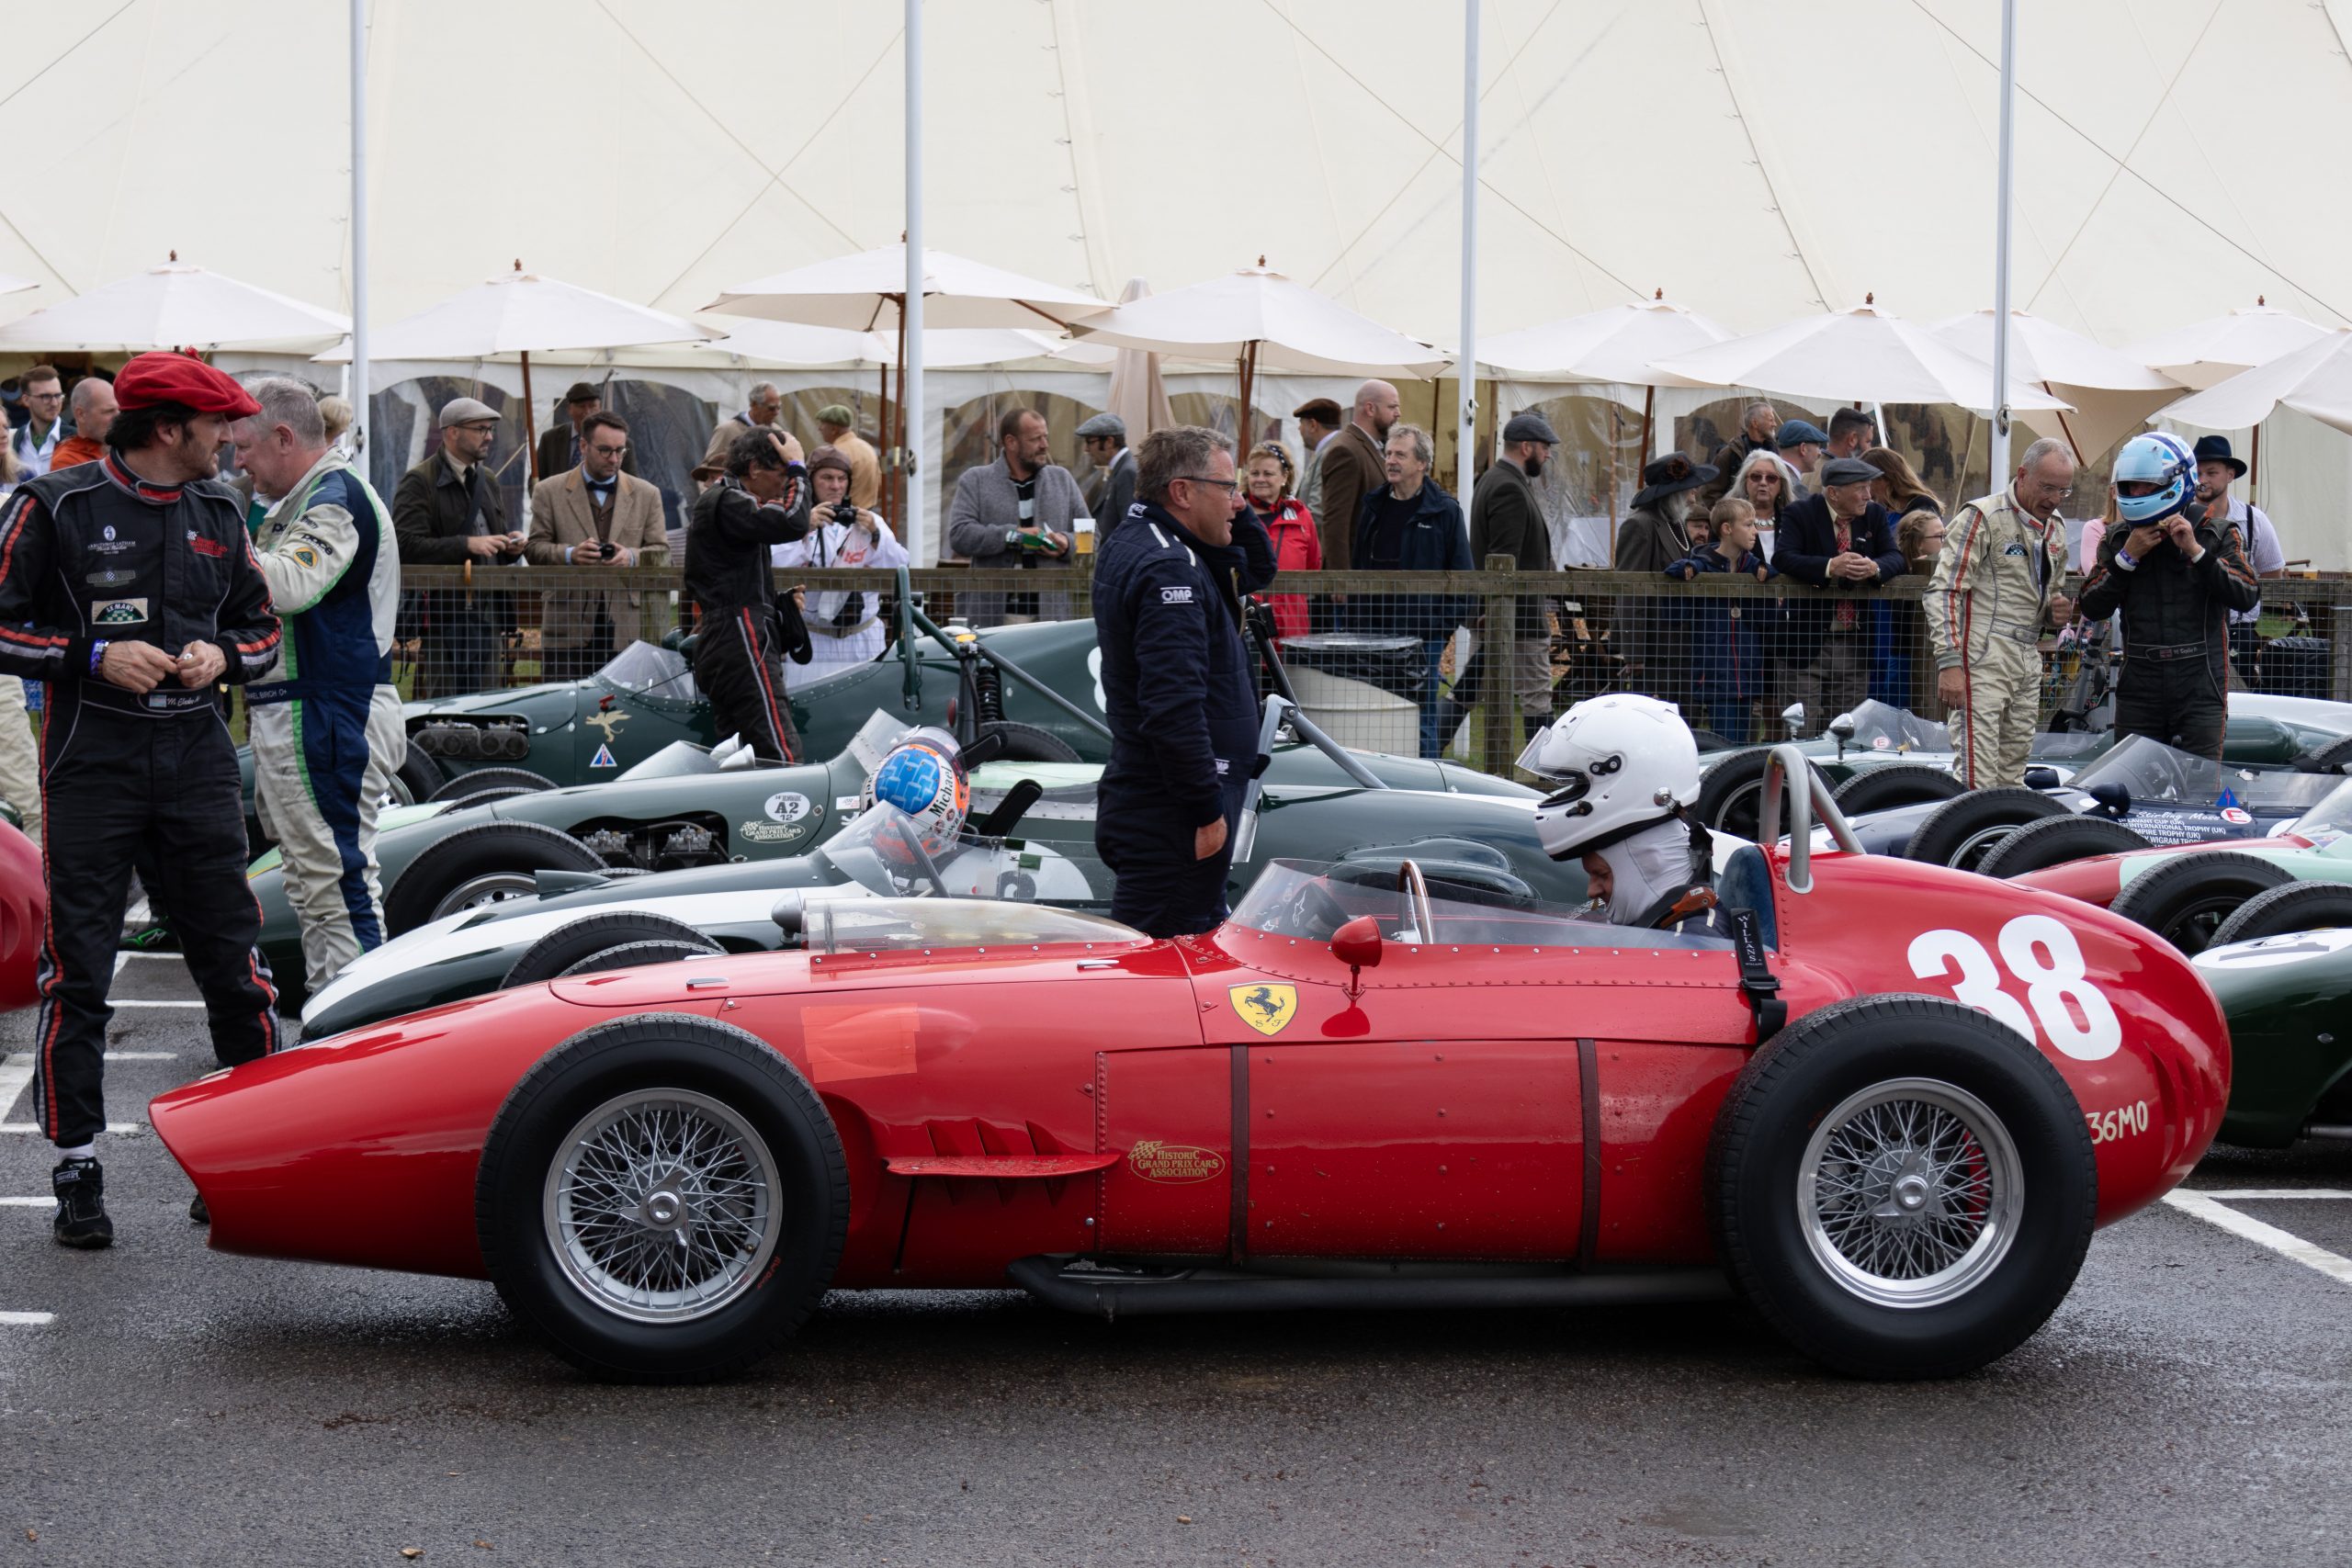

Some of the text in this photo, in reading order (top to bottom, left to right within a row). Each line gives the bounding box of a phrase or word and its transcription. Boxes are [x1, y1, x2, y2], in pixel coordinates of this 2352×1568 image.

[301, 533, 333, 556] pace
[1161, 589, 1193, 602] OMP
[929, 766, 954, 818] Michael
[775, 801, 799, 815] A2
[2225, 810, 2247, 823] E
[2129, 823, 2183, 831] INTERNATIONAL
[2183, 825, 2211, 833] TROPHY
[2211, 827, 2226, 835] (UK)
[2158, 829, 2185, 838] TROPHY
[2186, 831, 2201, 840] (UK)
[753, 832, 795, 841] ASSOCIATION
[2149, 836, 2179, 845] WIGRAM
[1737, 913, 1757, 962] WILLANS
[1907, 914, 2122, 1061] 38
[1157, 1150, 1200, 1160] HISTORIC
[1137, 1159, 1219, 1169] GRAND PRIX CARS
[1148, 1168, 1208, 1178] ASSOCIATION
